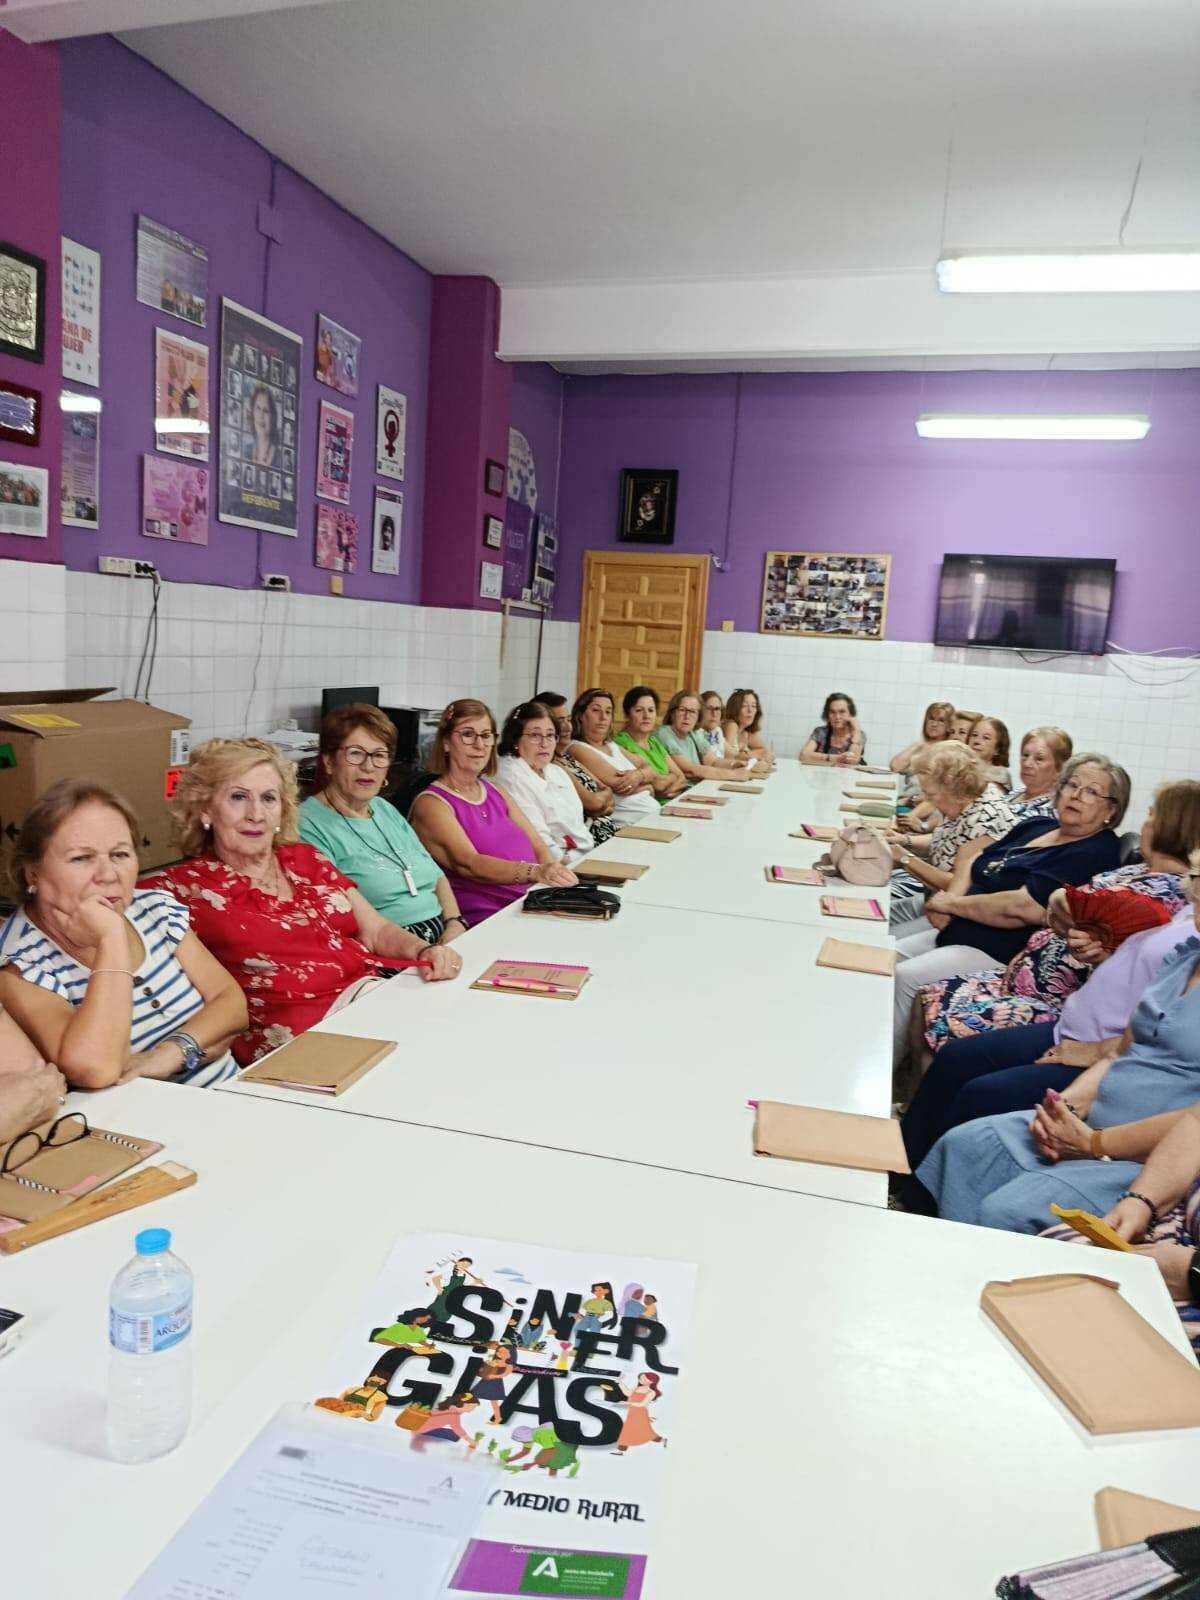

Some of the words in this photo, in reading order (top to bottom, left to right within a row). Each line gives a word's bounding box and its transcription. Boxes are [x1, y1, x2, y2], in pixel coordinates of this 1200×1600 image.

[81, 326, 93, 343] DE
[503, 1490, 570, 1513] MEDIO
[577, 1499, 646, 1522] RURAL
